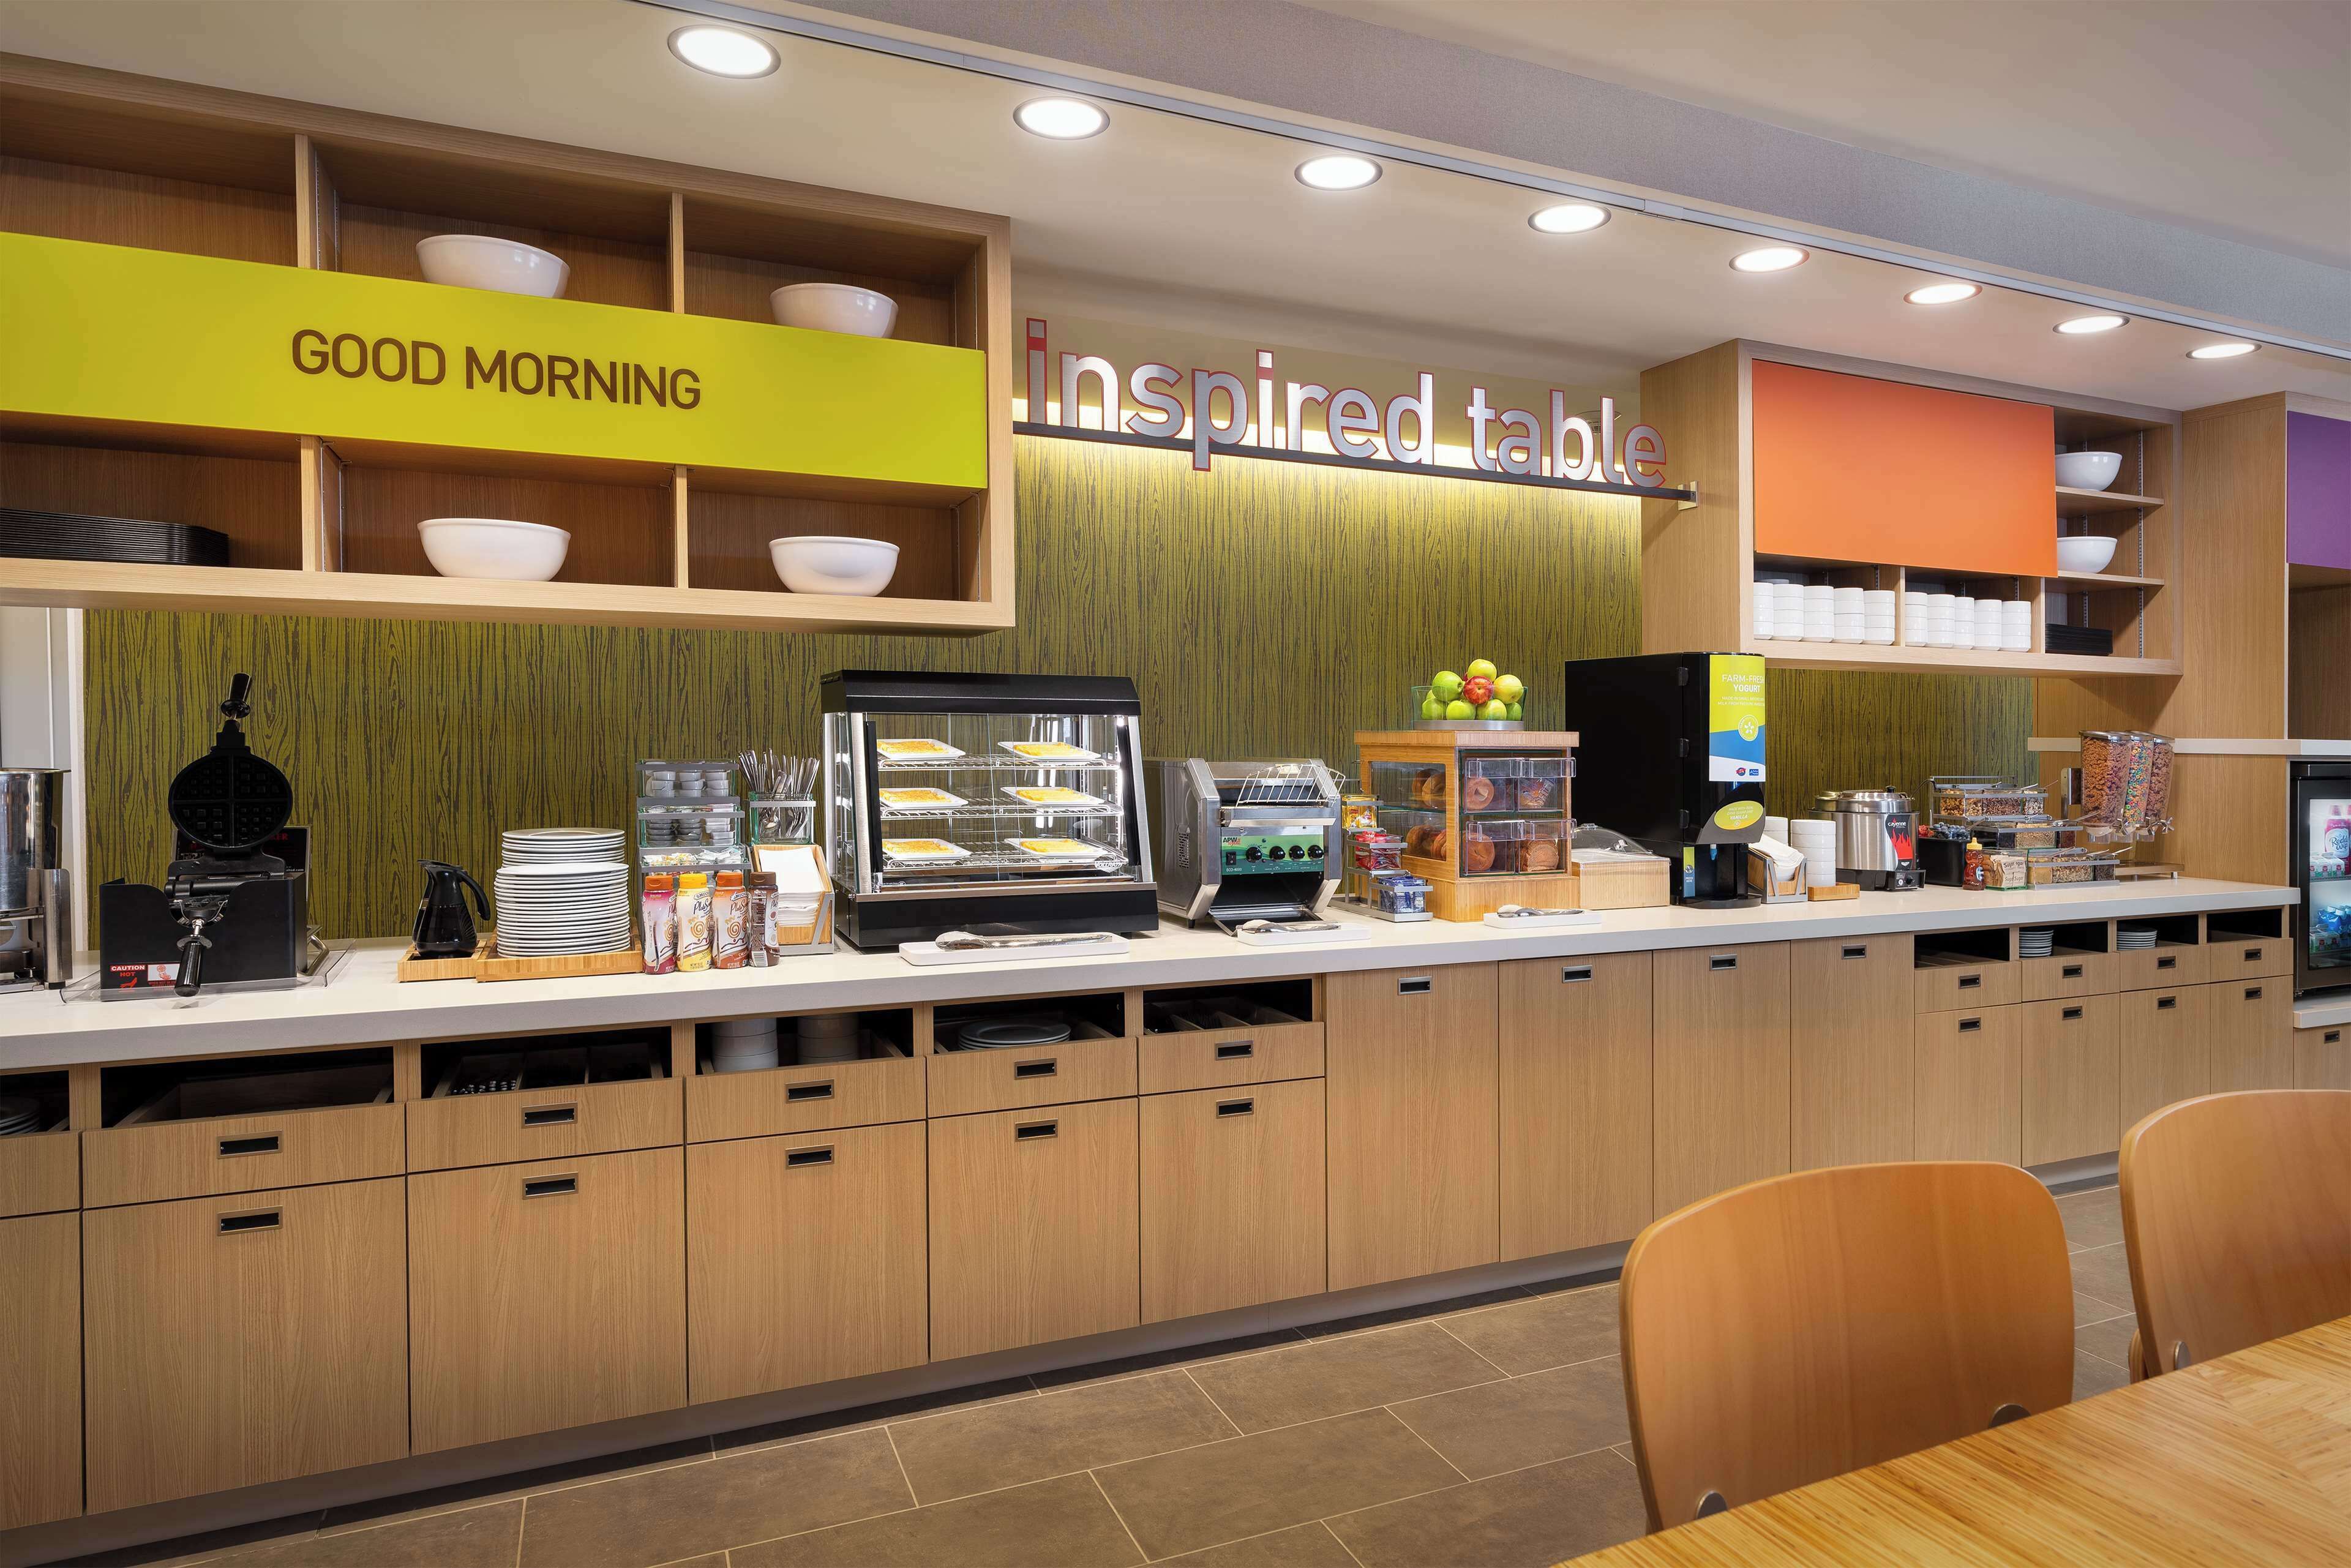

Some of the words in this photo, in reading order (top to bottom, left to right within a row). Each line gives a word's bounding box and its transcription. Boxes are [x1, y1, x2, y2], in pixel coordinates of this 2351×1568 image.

[292, 329, 446, 386] GOOD
[466, 347, 701, 410] MORNING
[1026, 317, 1434, 472] inspired
[1466, 386, 1667, 487] table
[1734, 684, 1760, 692] YOGURT
